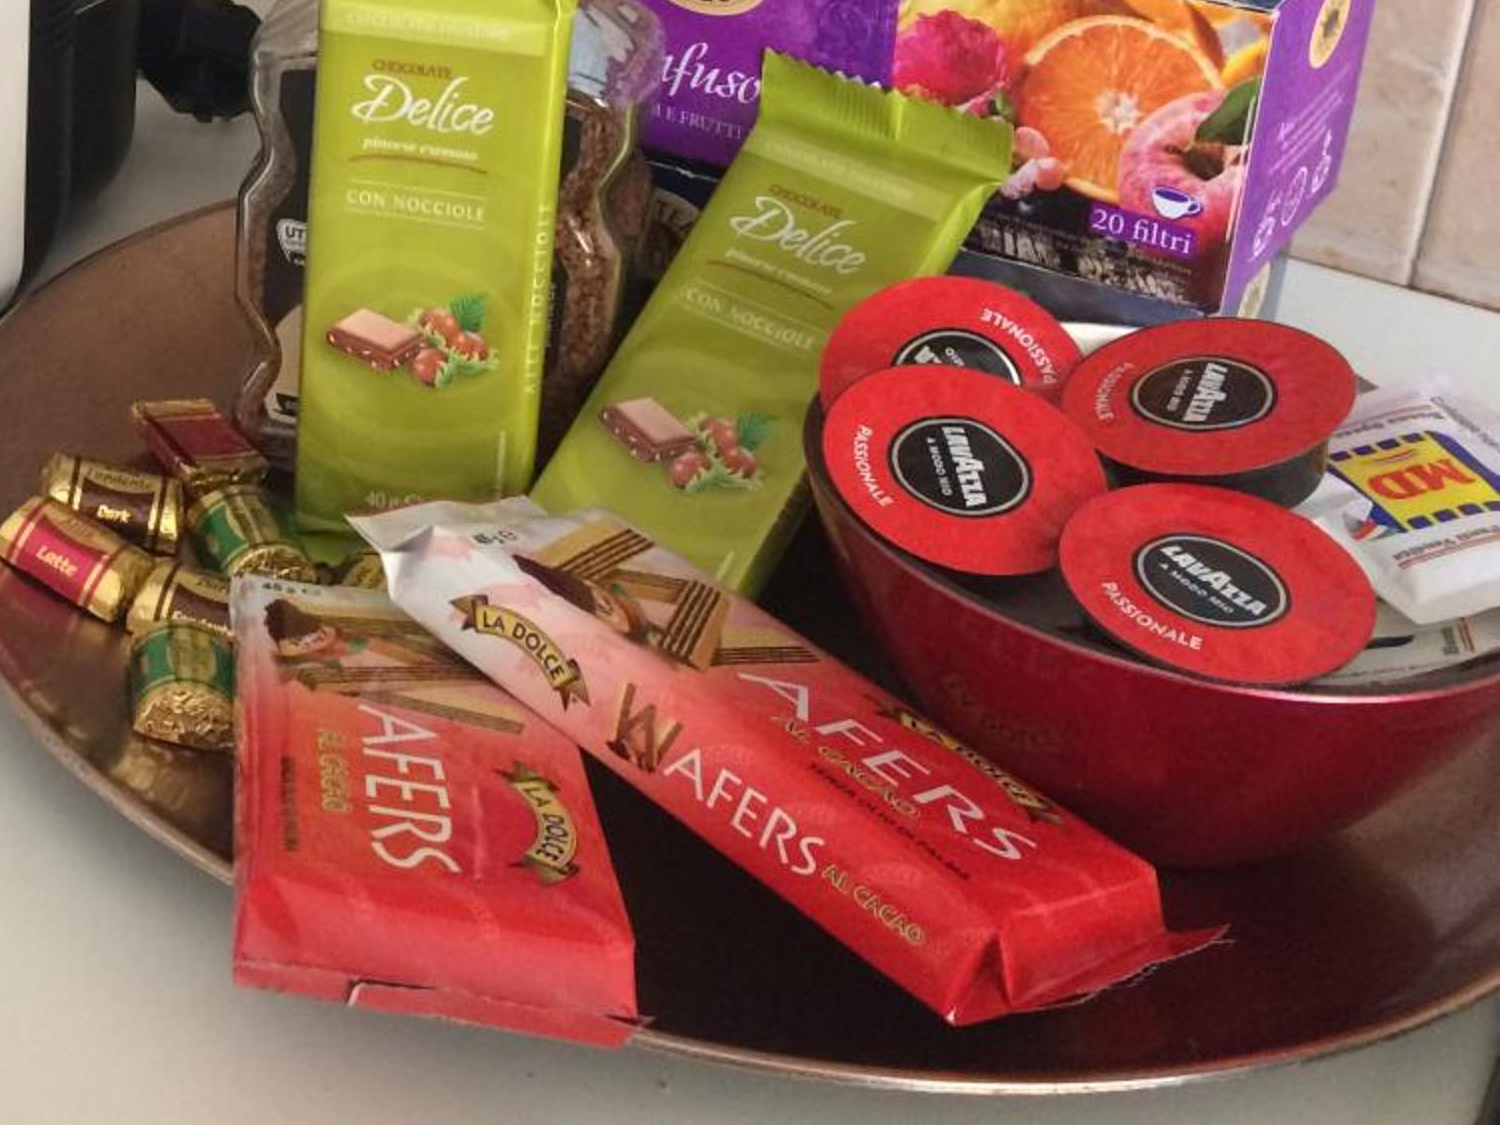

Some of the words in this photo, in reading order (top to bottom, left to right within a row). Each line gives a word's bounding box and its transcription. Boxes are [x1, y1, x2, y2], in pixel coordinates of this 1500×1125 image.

[372, 59, 452, 79] CHOCOLATE
[351, 74, 495, 135] Delice
[285, 225, 308, 239] UT
[346, 188, 387, 208] CON
[394, 194, 485, 221] NOCCIOLE
[729, 195, 866, 275] Delice
[1091, 209, 1125, 235] 20
[1132, 219, 1193, 255] filtri
[685, 287, 721, 314] CON
[730, 307, 814, 350] NOCCIOLE
[980, 307, 1058, 385] PASSIONALE
[1182, 362, 1229, 422] LAVAZZA
[853, 425, 895, 508] PASSIONALE
[941, 426, 988, 508] LAVAZZA
[1368, 458, 1477, 500] MD
[1160, 545, 1267, 617] LAVAZZA
[482, 610, 506, 633] LA
[512, 622, 566, 681] DOLCE
[1100, 580, 1205, 651] PASSIONALE
[522, 786, 551, 808] LA
[535, 813, 567, 862] DOLCE
[852, 884, 926, 945] CACAO
